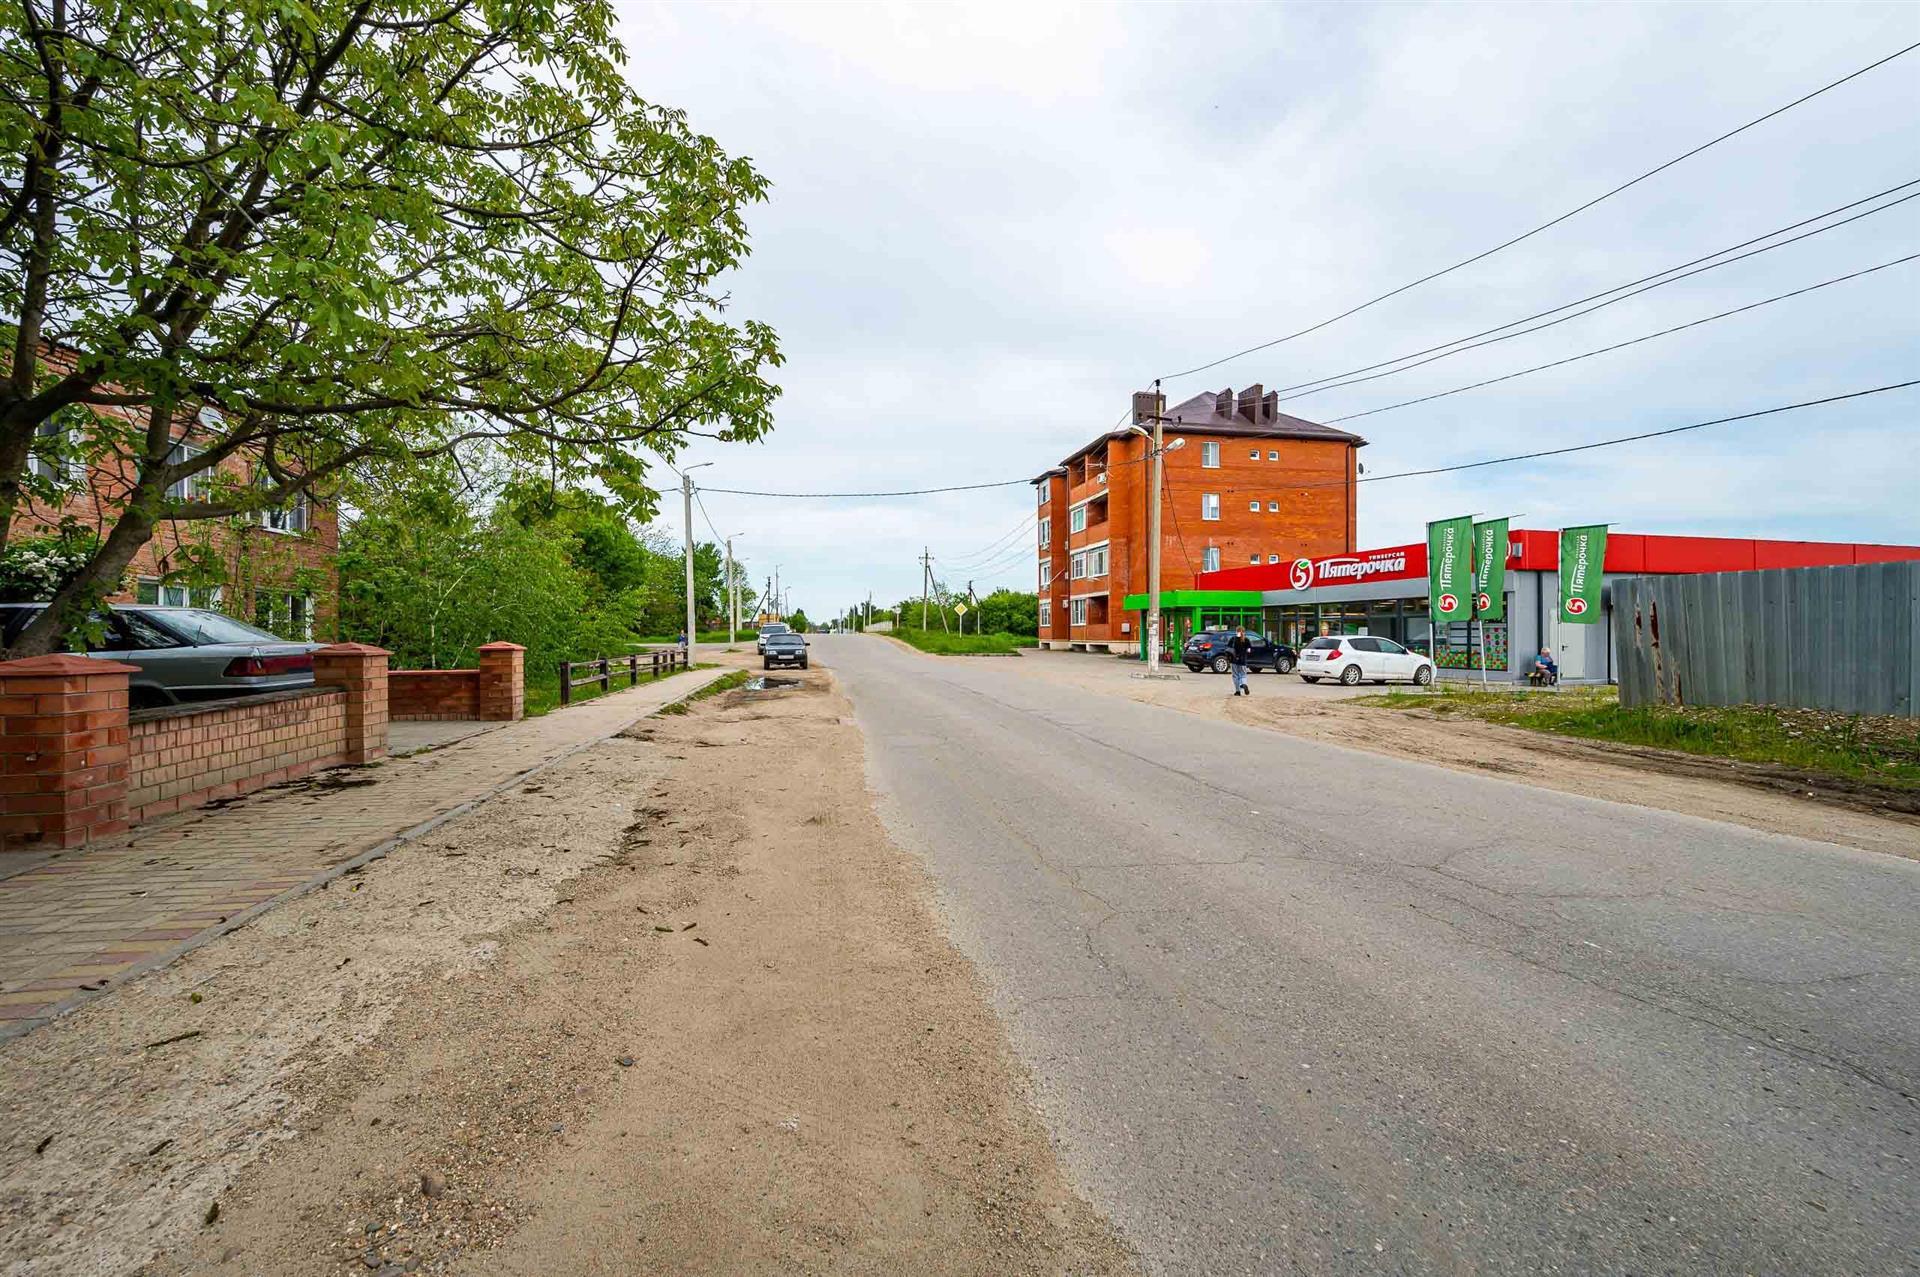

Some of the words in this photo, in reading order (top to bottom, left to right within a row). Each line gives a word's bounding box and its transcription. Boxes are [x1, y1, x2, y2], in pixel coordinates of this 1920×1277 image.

[1315, 558, 1405, 580] Пятерочка
[1440, 527, 1456, 591] Пятерочка
[1571, 535, 1588, 595] Пятерочка
